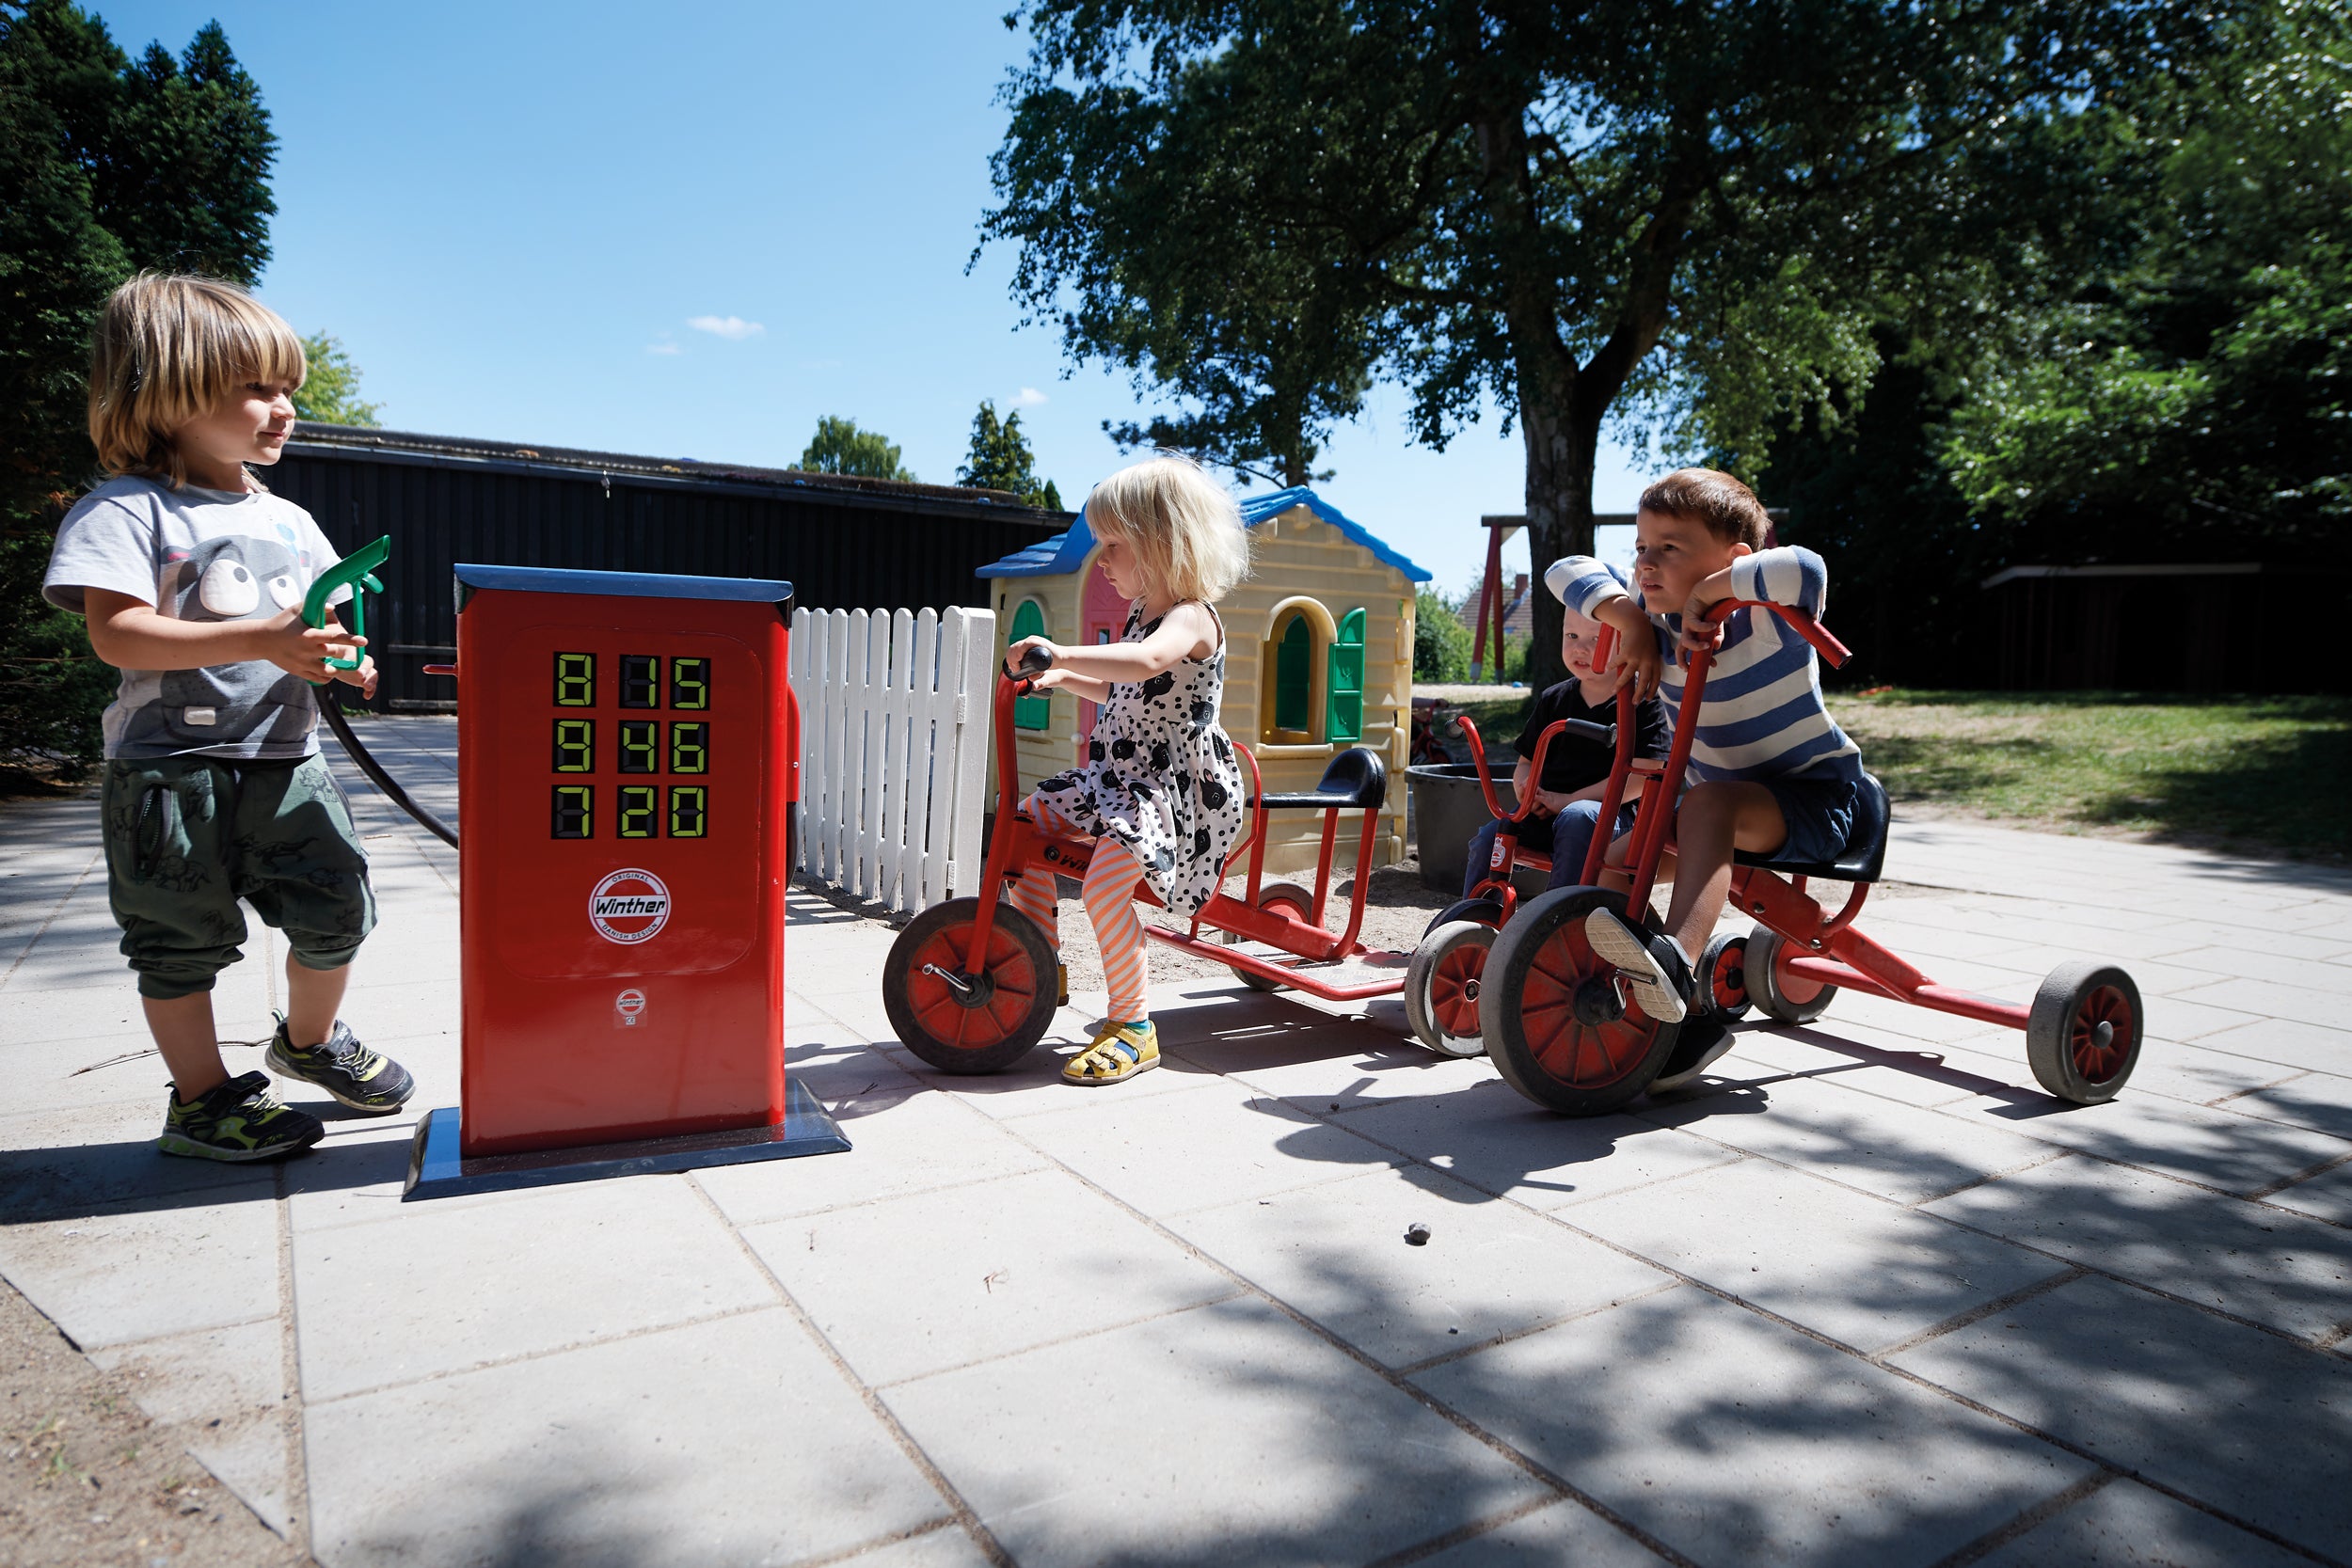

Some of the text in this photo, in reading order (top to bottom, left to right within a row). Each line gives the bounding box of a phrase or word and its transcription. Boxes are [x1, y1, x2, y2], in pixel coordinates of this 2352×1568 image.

[558, 654, 592, 705] 8
[557, 721, 591, 772] 9
[557, 786, 590, 838] 7
[612, 873, 649, 882] ORIGINAL
[596, 898, 665, 914] Winther
[602, 923, 658, 939] DANISH DESIGN
